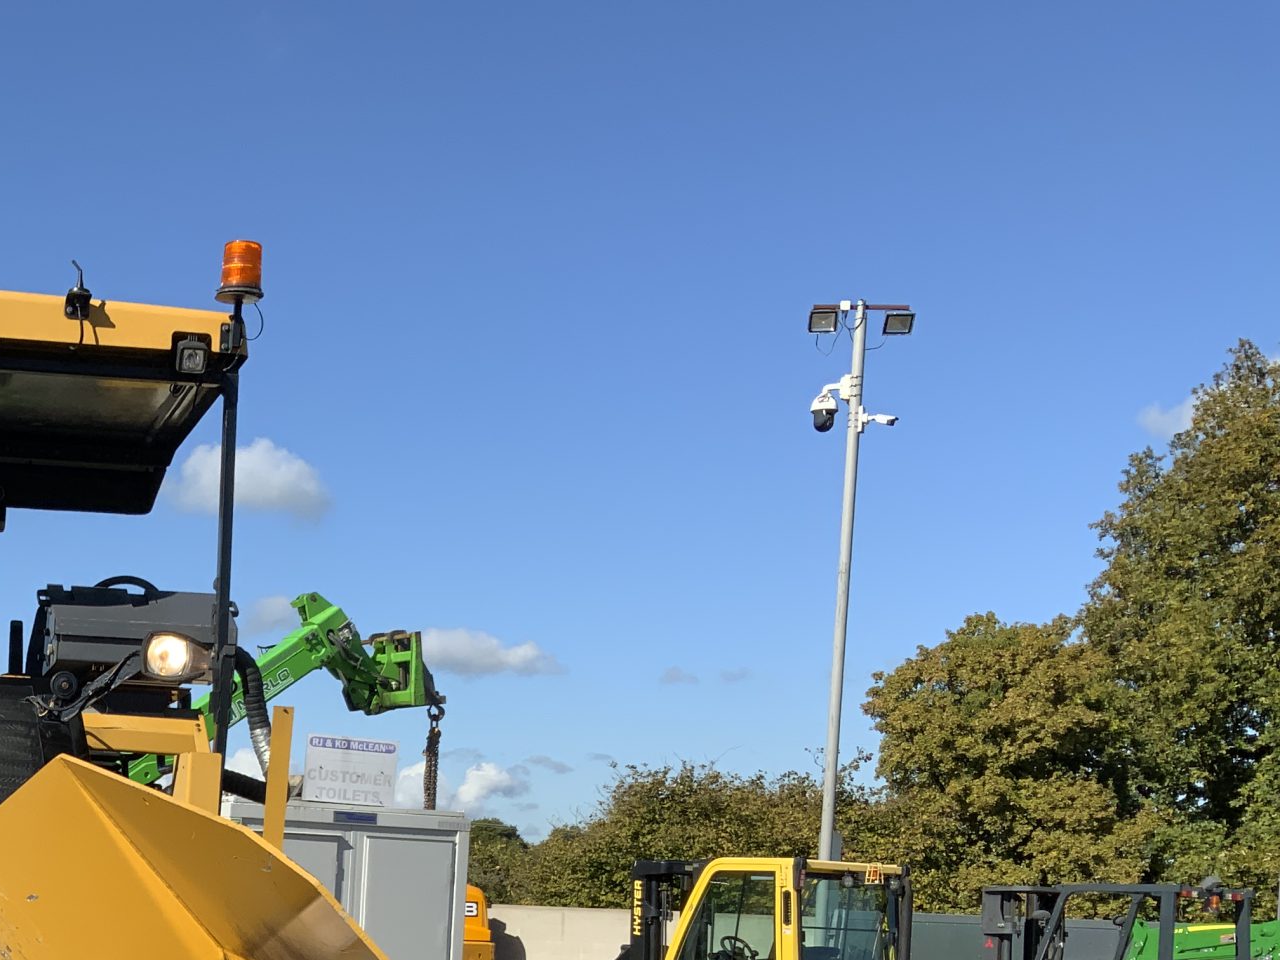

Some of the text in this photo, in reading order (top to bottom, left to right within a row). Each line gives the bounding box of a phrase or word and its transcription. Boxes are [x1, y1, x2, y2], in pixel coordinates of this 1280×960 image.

[312, 737, 323, 747] RJ
[325, 739, 333, 747] &
[335, 740, 348, 749] KD
[307, 768, 392, 787] CUSTOMER
[317, 786, 380, 804] TOILETS
[633, 880, 642, 936] HYSTER
